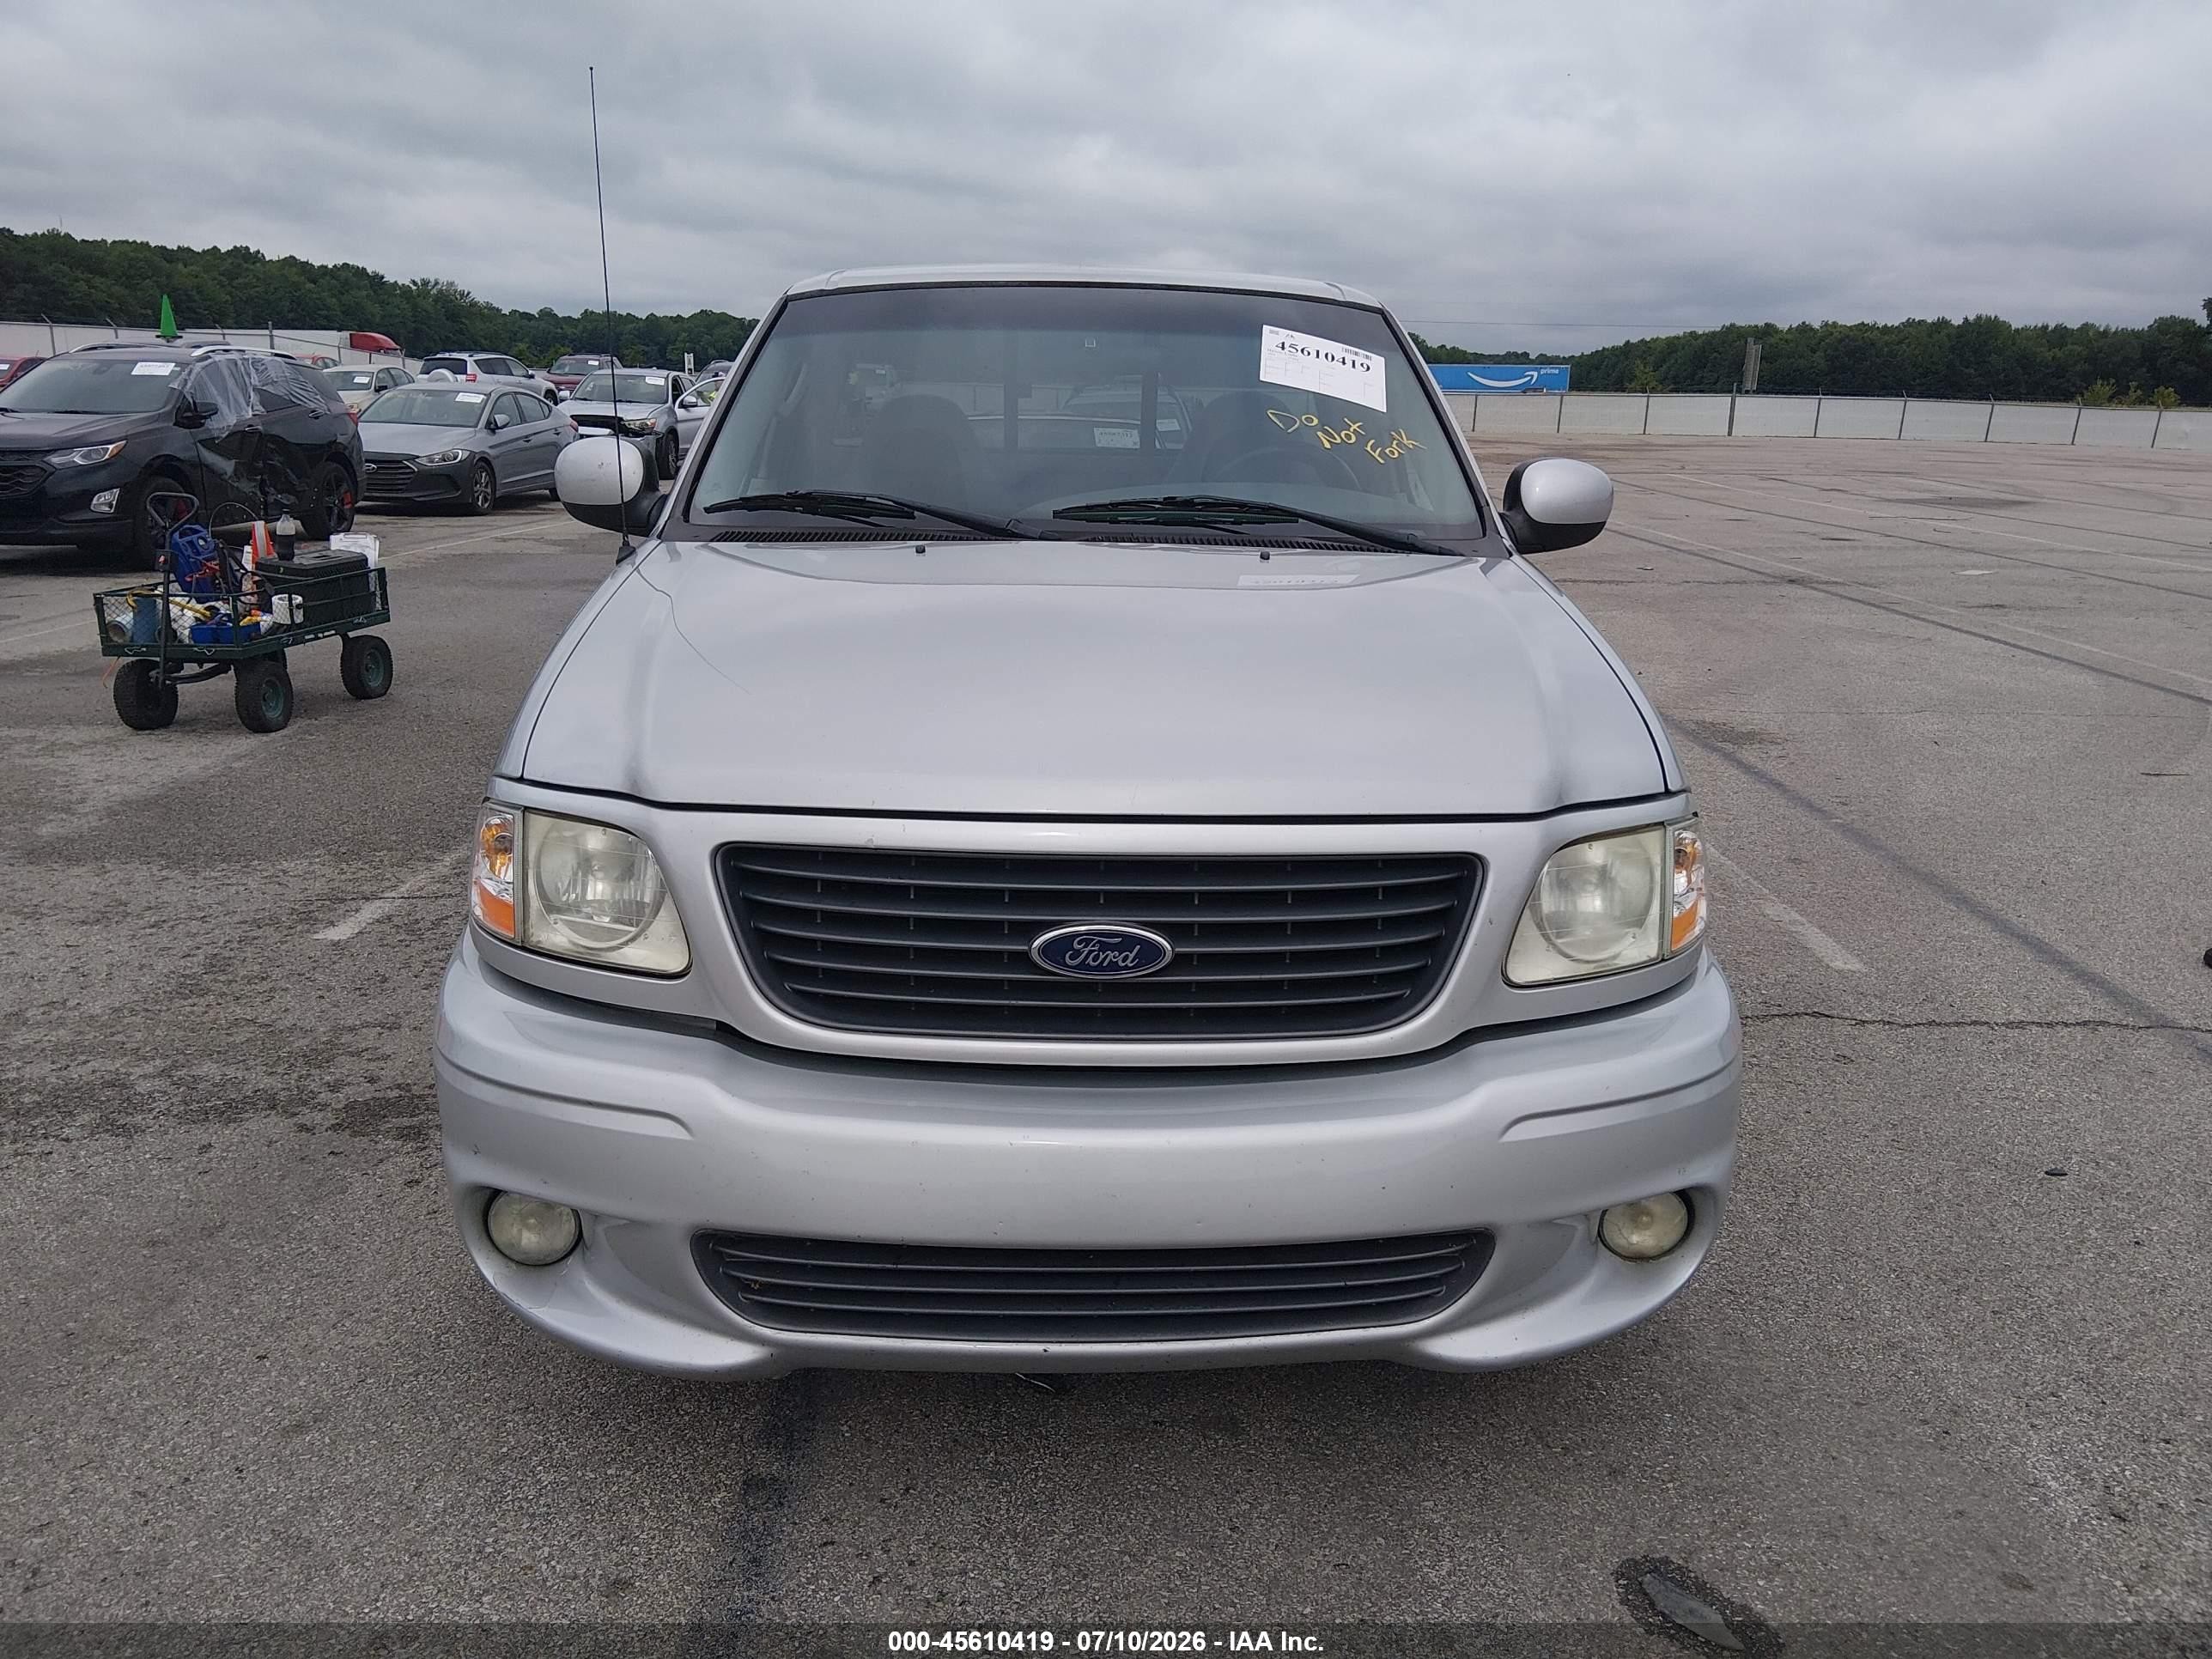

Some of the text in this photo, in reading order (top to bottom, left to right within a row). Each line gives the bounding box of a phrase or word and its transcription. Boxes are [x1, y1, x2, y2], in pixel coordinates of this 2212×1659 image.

[1275, 341, 1370, 373] 45610419
[1267, 410, 1427, 465] Do Not Fork
[1066, 936, 1141, 967] Ford
